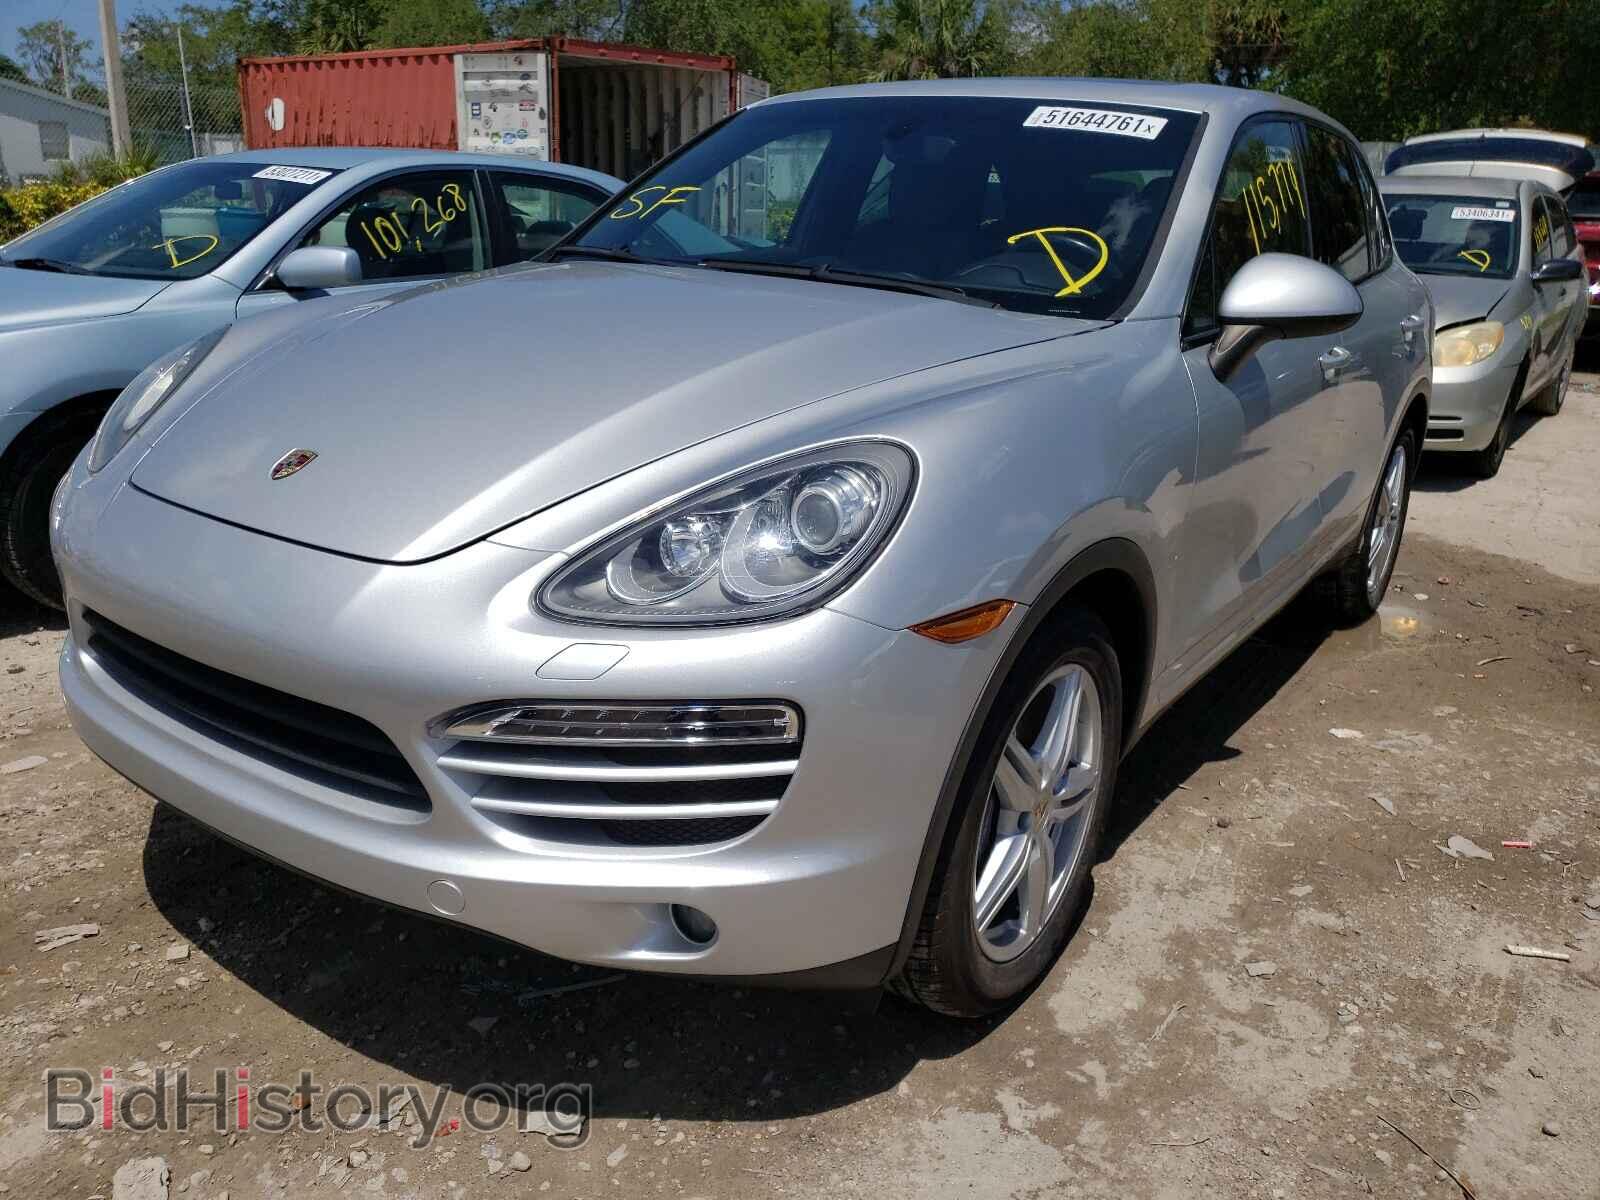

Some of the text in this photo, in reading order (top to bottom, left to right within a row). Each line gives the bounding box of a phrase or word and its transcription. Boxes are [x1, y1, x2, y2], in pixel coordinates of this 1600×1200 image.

[1043, 110, 1145, 133] 51644761
[610, 186, 703, 220] SF
[361, 183, 467, 259] 101,268
[152, 234, 218, 268] D
[1007, 226, 1109, 298] D
[1457, 249, 1490, 273] D
